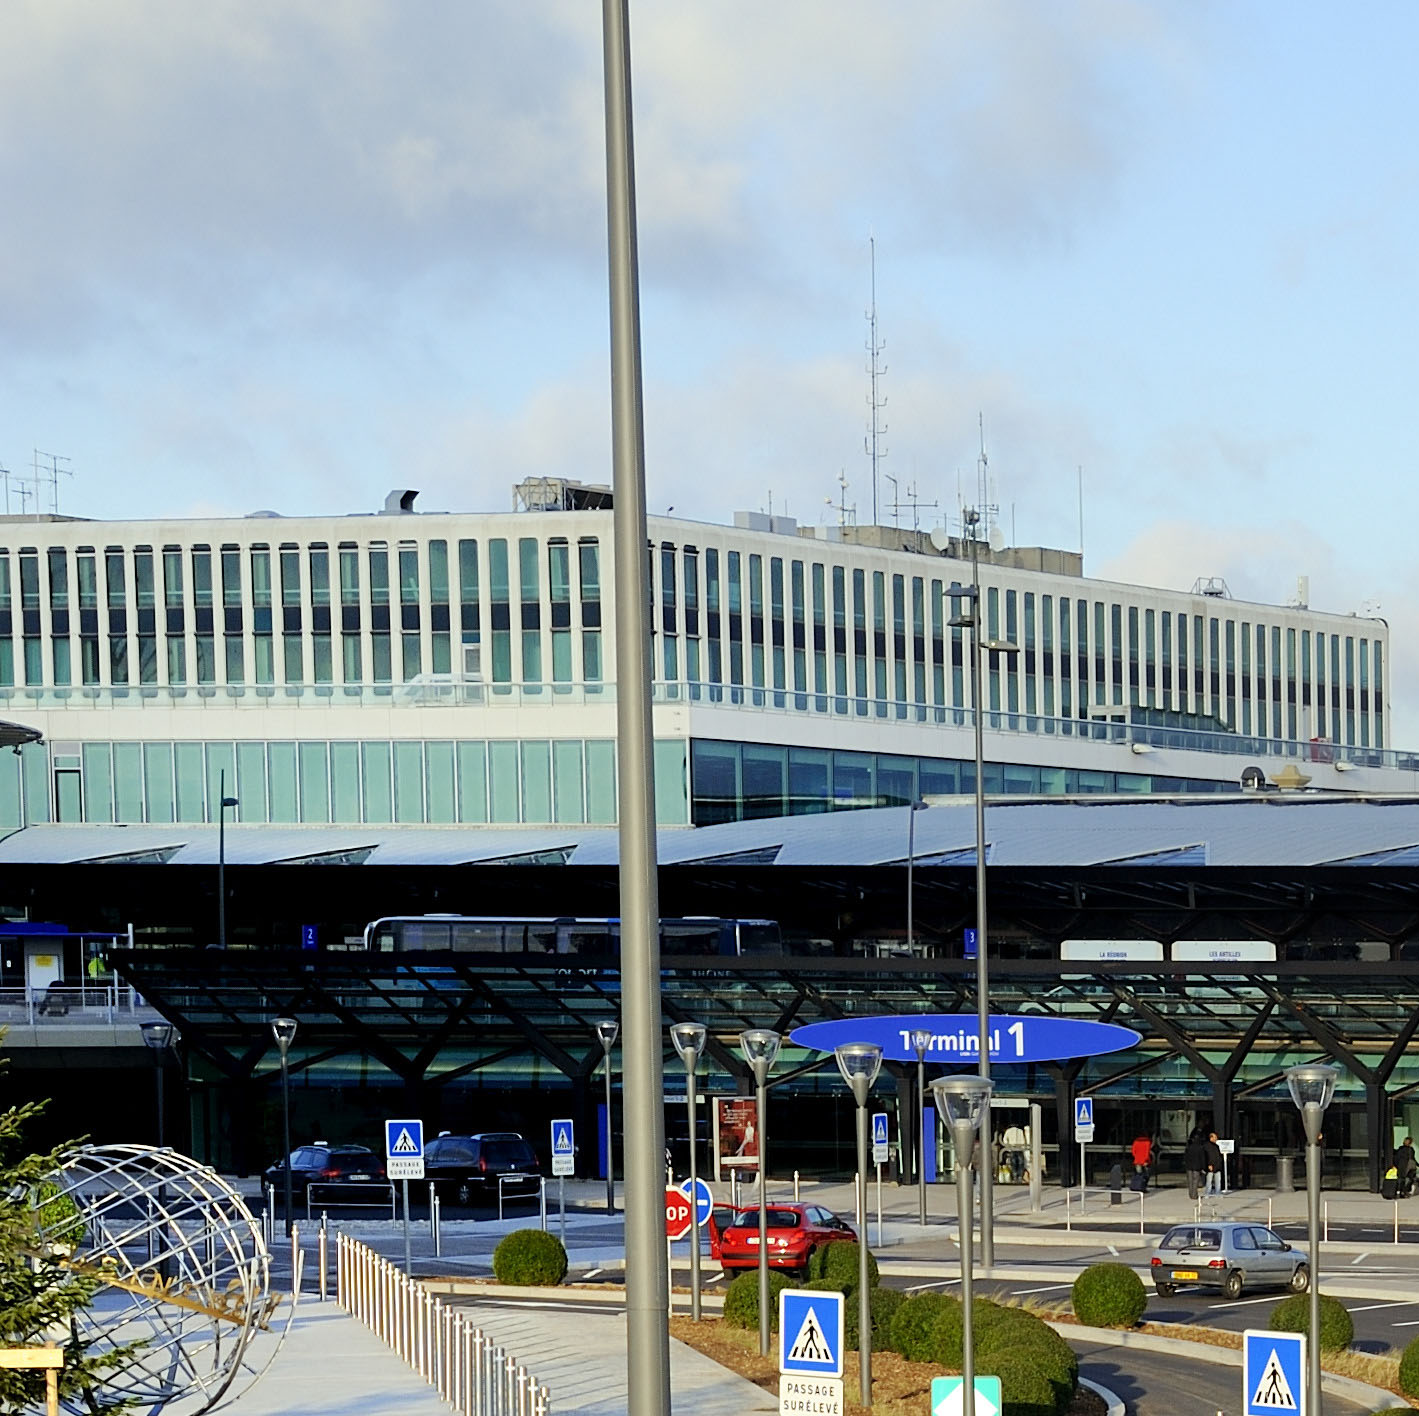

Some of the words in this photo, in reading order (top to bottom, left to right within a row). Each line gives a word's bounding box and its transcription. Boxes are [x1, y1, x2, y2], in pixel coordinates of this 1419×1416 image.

[307, 928, 313, 940] 2
[970, 931, 975, 943] 3
[1008, 1021, 1024, 1057] 1
[667, 1206, 690, 1222] OP
[787, 1383, 835, 1397] PASSAGE
[783, 1400, 839, 1415] SURÉLEVÉ
